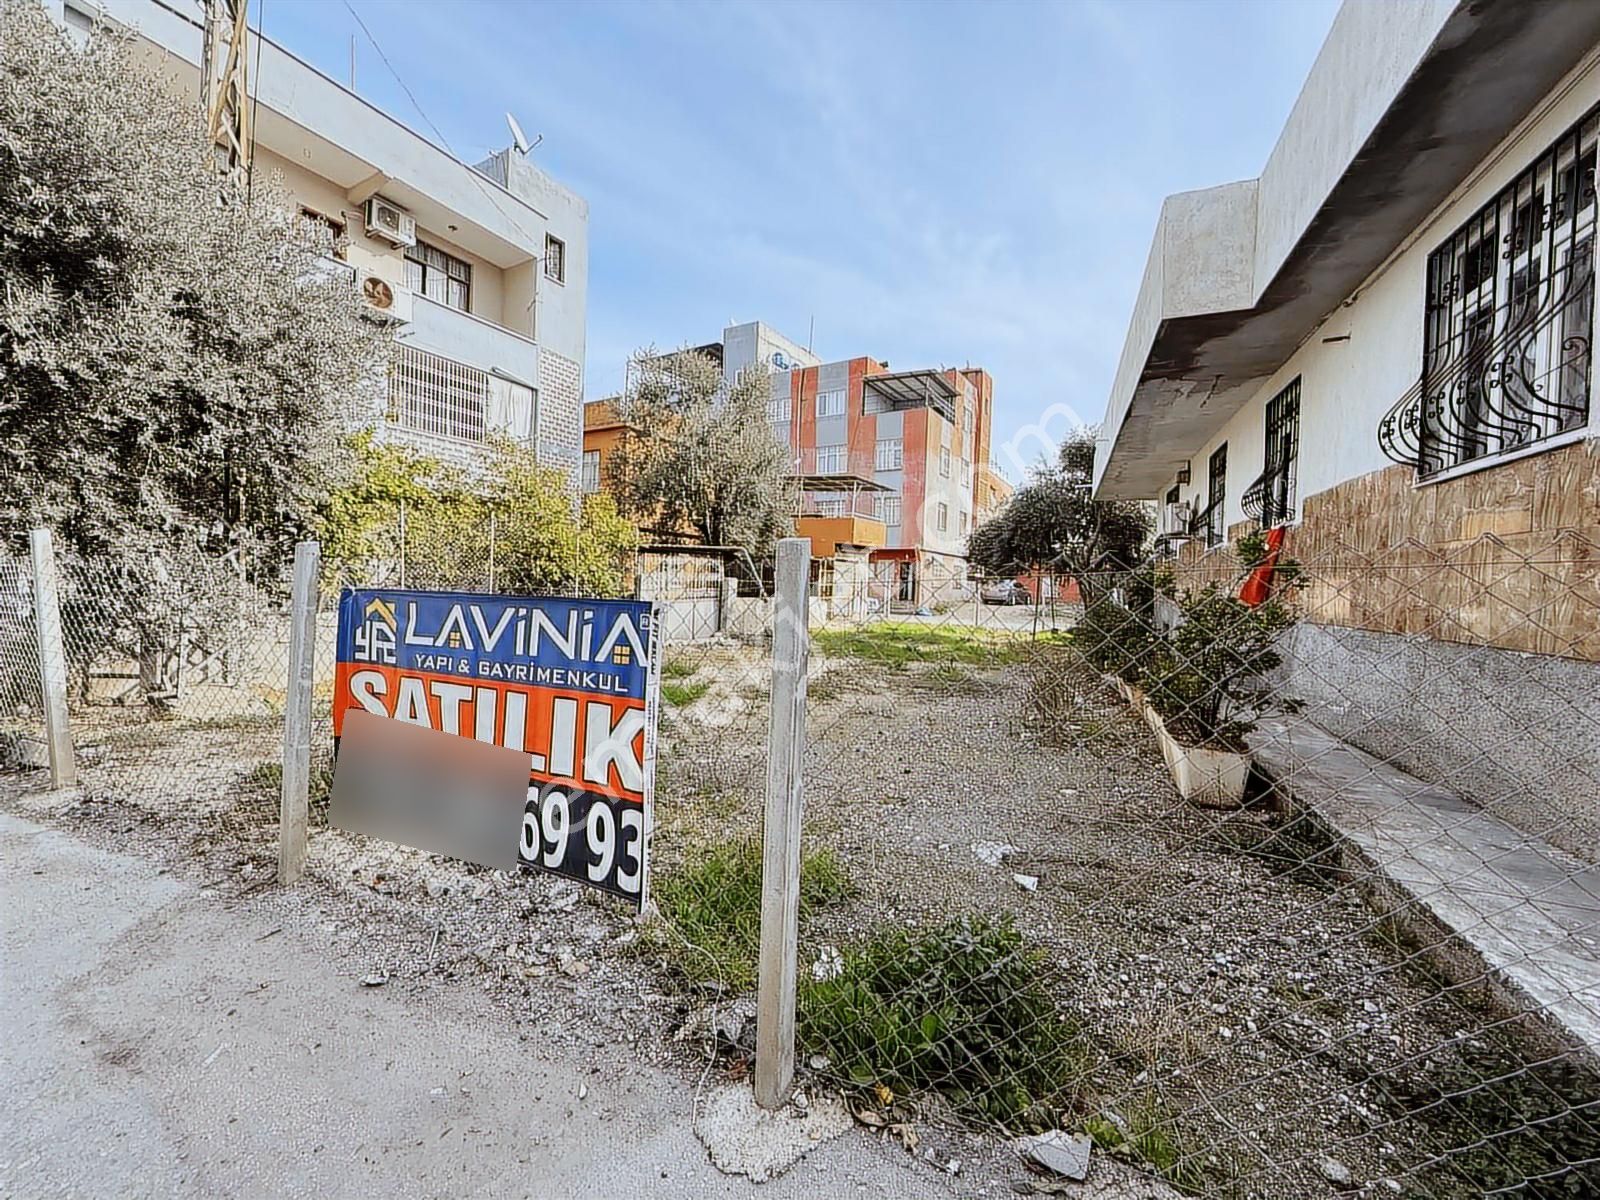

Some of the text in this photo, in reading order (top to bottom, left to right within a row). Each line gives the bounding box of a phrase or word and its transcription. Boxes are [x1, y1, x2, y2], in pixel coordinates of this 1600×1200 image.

[415, 653, 629, 693] YAPI & GAYRİMENKUL
[587, 801, 643, 893] 93
